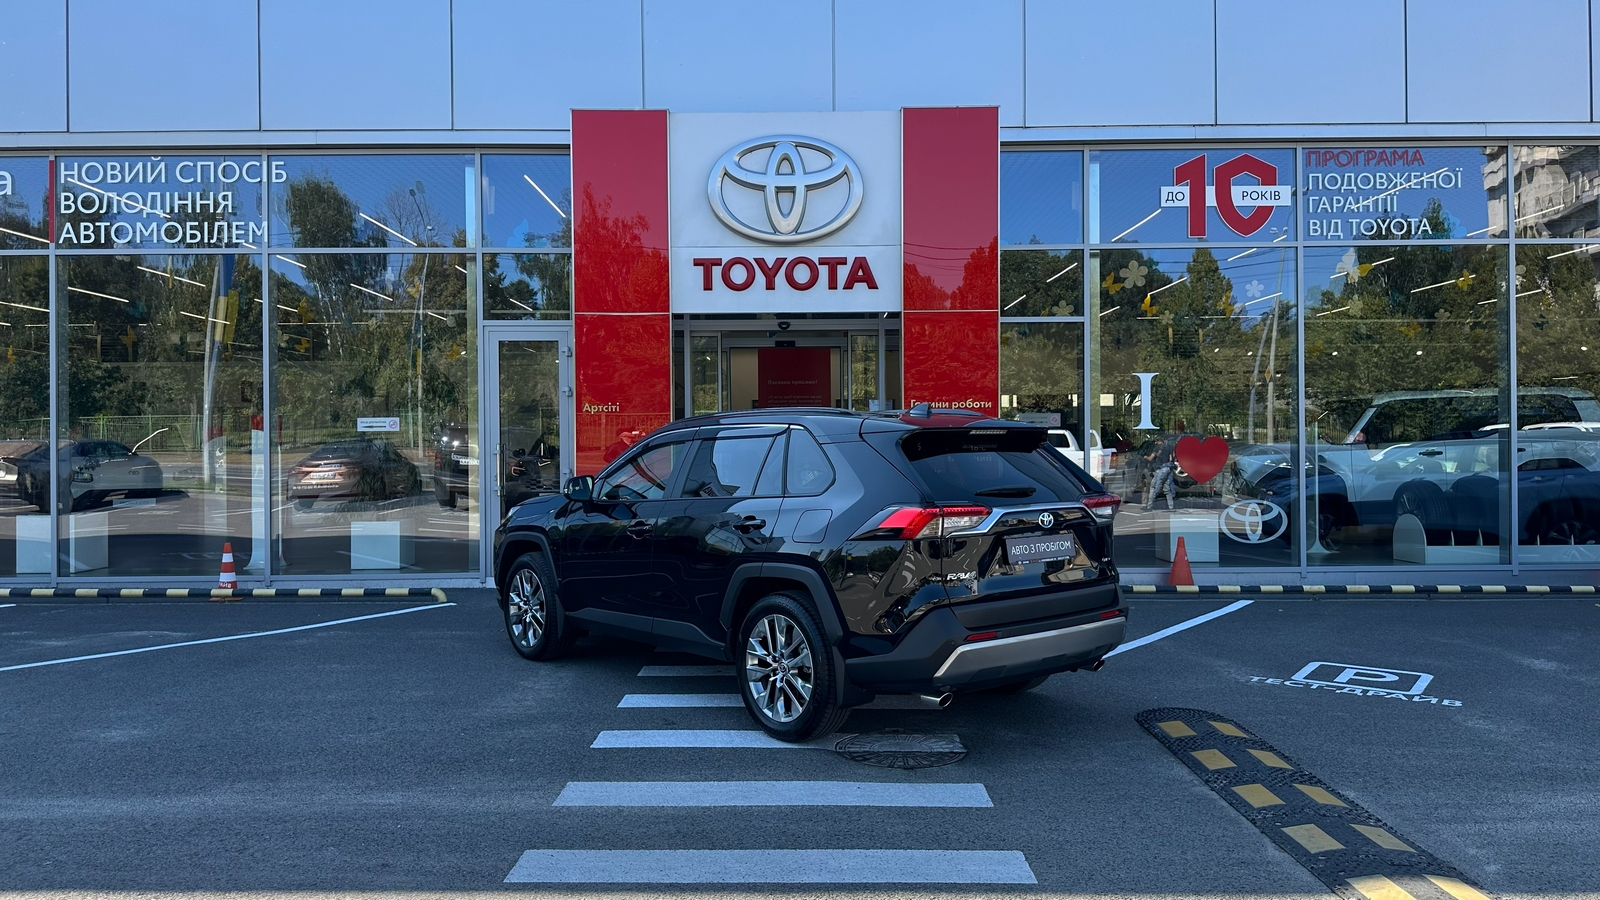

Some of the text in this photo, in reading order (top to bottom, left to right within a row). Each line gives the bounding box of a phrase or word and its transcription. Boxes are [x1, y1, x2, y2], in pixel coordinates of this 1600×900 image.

[60, 156, 288, 184] НОВИЙ СПОСІБ
[1306, 150, 1425, 167] ПРОГРАМА
[1308, 168, 1463, 192] ПОДОВЖЕНОЇ
[60, 191, 233, 218] ВОЛОДІННЯ
[1165, 153, 1282, 238] ДО 10 РОКІВ
[1308, 192, 1398, 213] ГАРАНТІЇ
[58, 221, 269, 244] АВТОМОБІЛЕМ
[1309, 217, 1432, 239] ВІД TOYOTA
[693, 256, 879, 291] TOYOTA
[583, 402, 620, 414] Артсіті
[951, 398, 992, 410] роботи
[1011, 544, 1029, 556] АВТО
[1036, 540, 1072, 553] ПРОБІГОМ
[1249, 675, 1463, 707] ТЕСТ-ДРАЙВ
